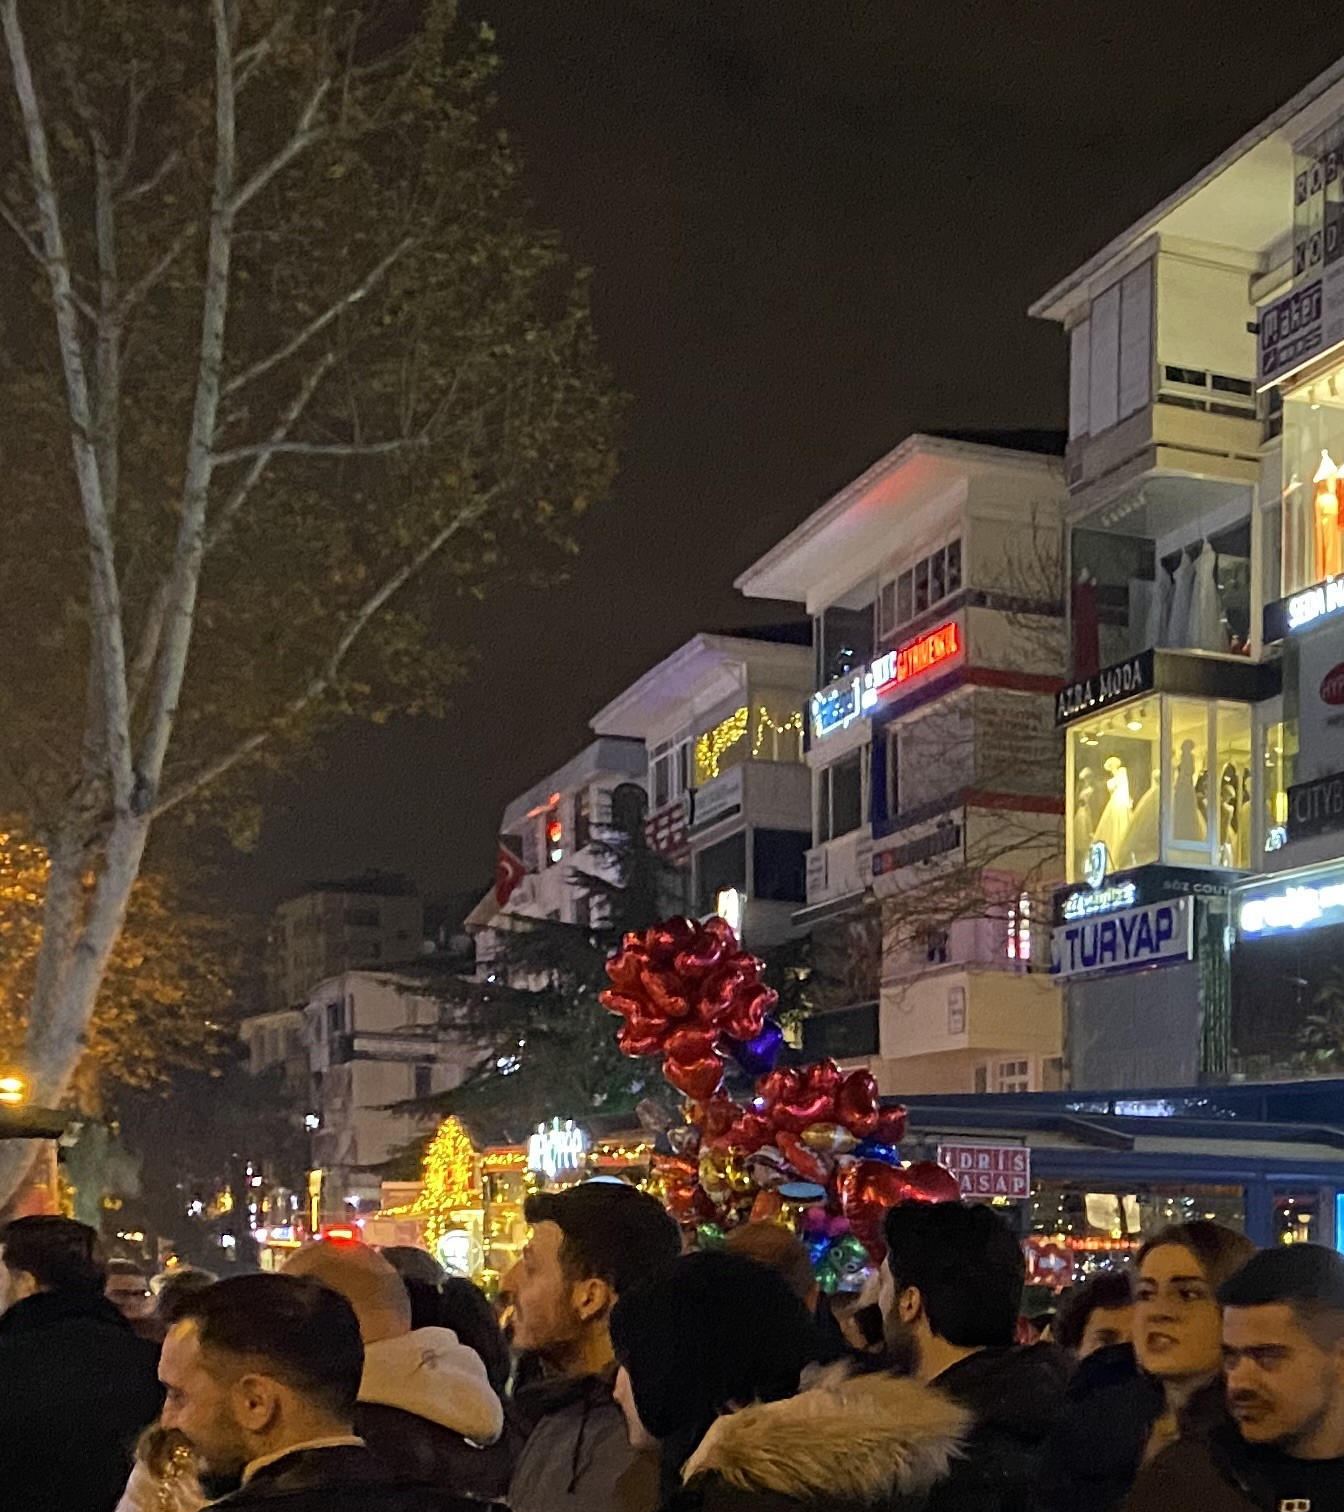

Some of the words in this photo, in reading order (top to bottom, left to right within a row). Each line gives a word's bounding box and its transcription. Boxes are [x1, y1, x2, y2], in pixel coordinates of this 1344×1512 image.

[1099, 660, 1141, 702] MODA
[1193, 882, 1229, 896] COUT
[1065, 907, 1173, 971] TURYAP
[960, 1174, 1025, 1193] ASAP
